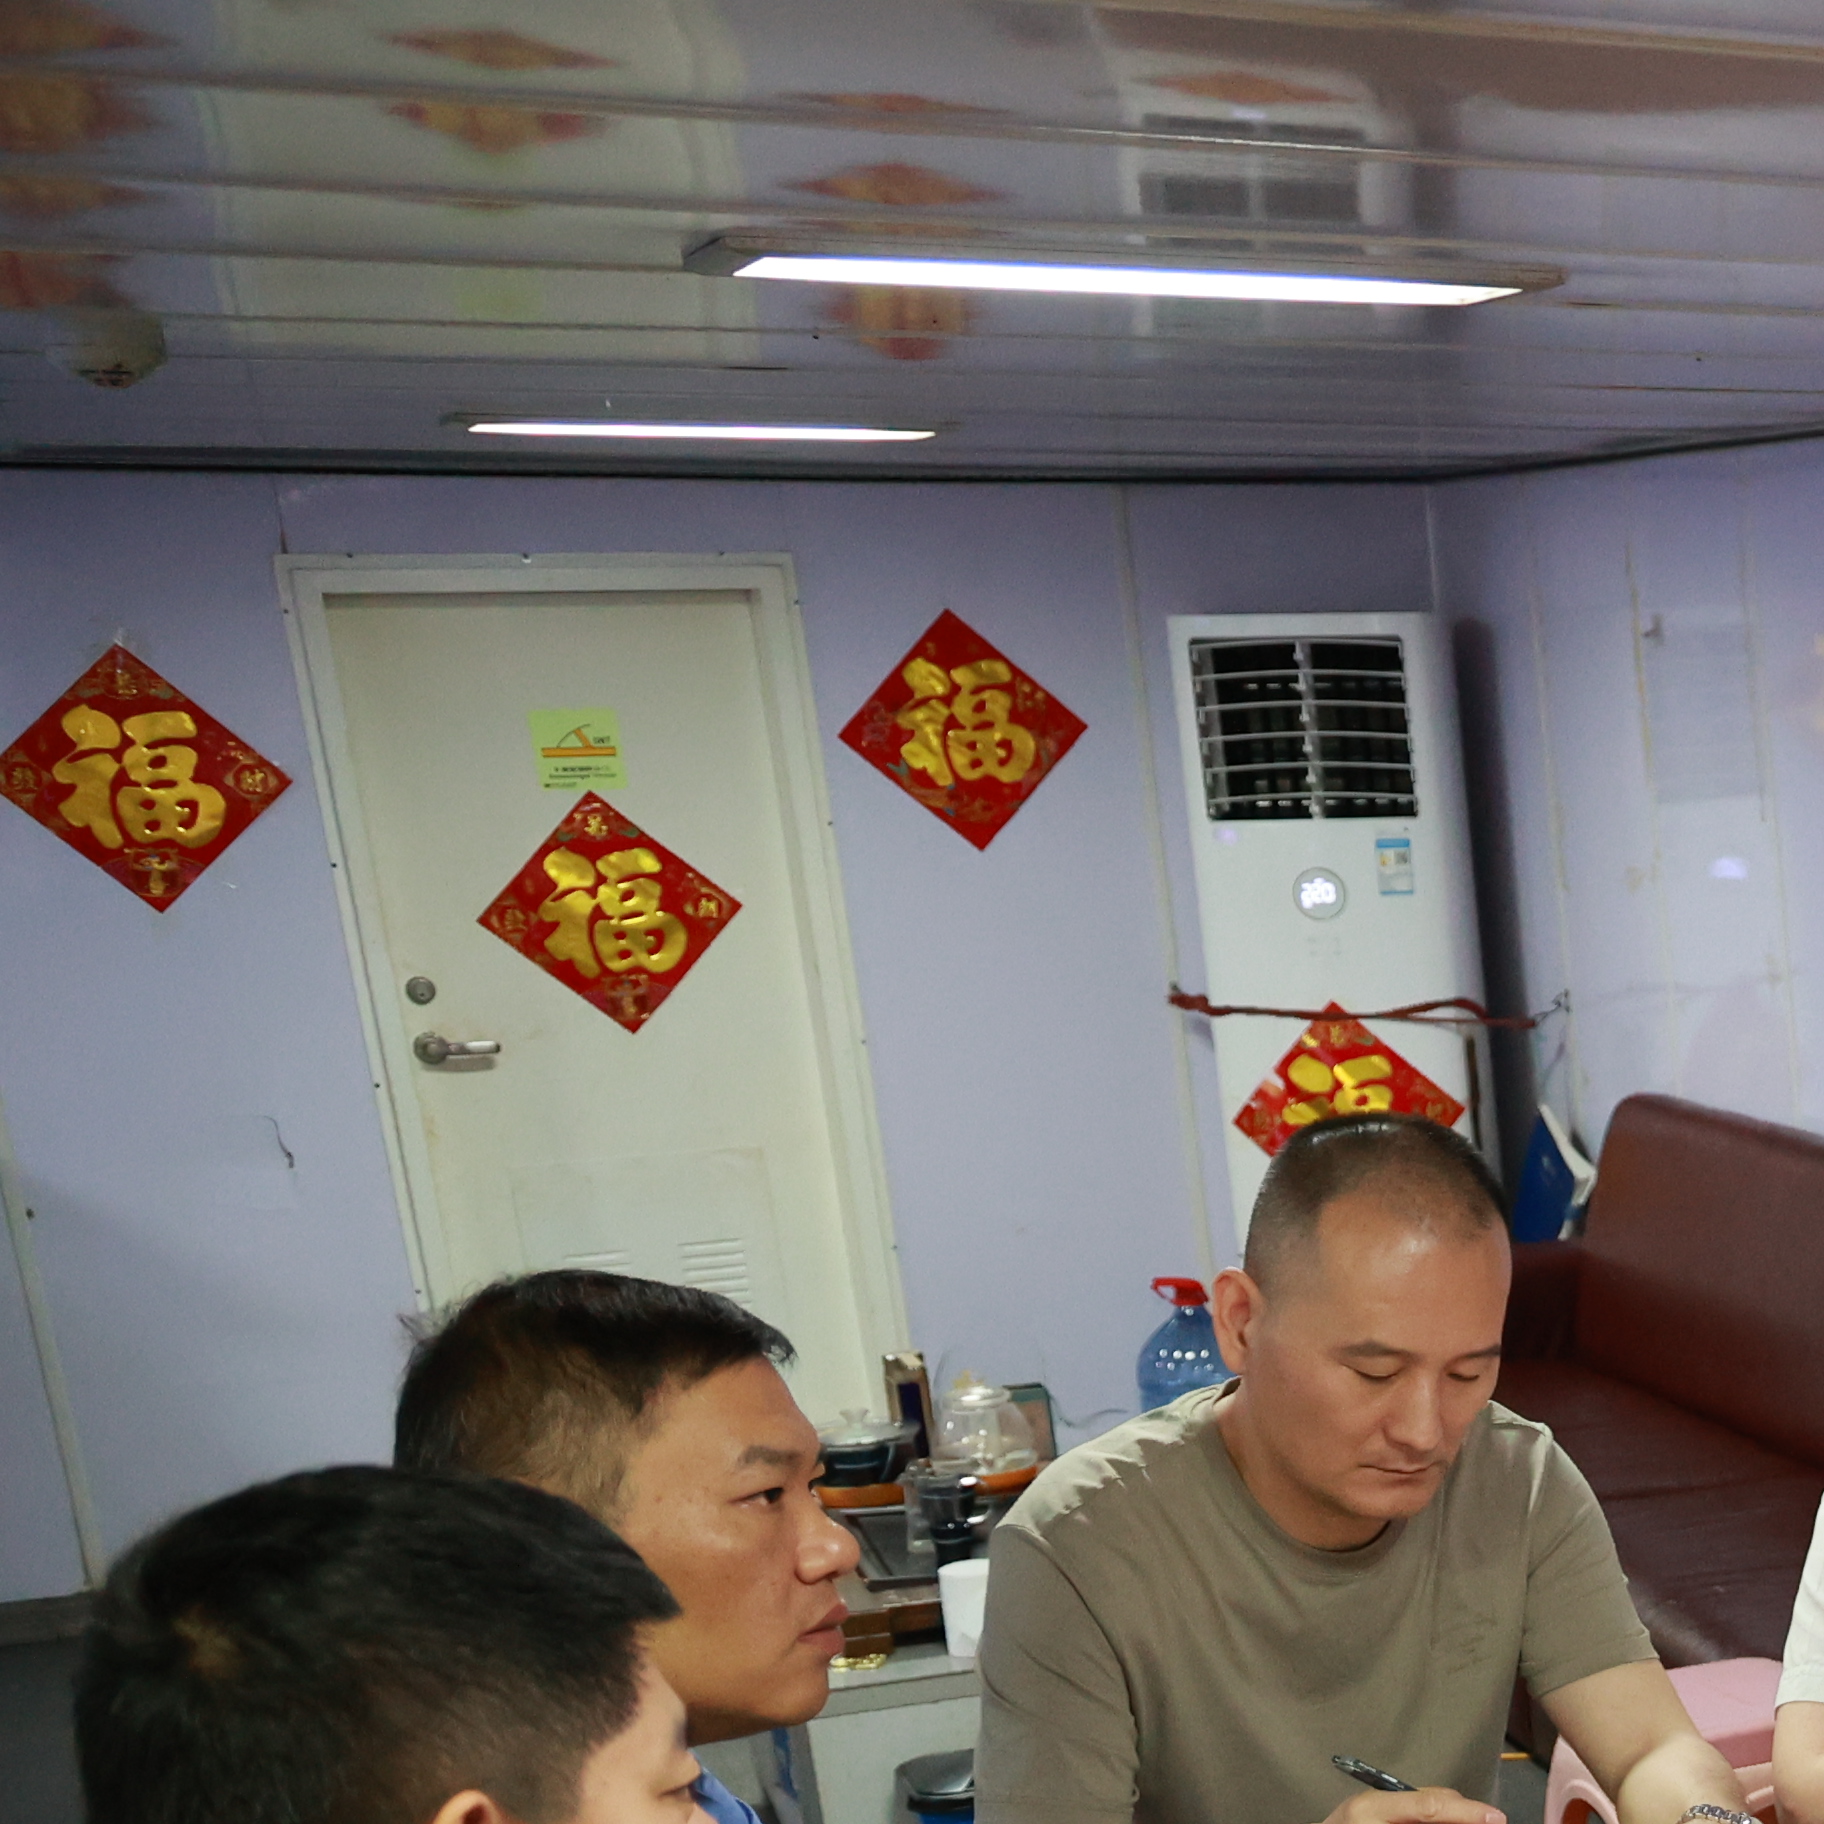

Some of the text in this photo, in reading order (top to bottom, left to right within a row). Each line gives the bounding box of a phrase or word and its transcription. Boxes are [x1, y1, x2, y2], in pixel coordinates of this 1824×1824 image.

[53, 703, 227, 849] 福
[897, 657, 1036, 787] 福
[538, 846, 688, 979] 福
